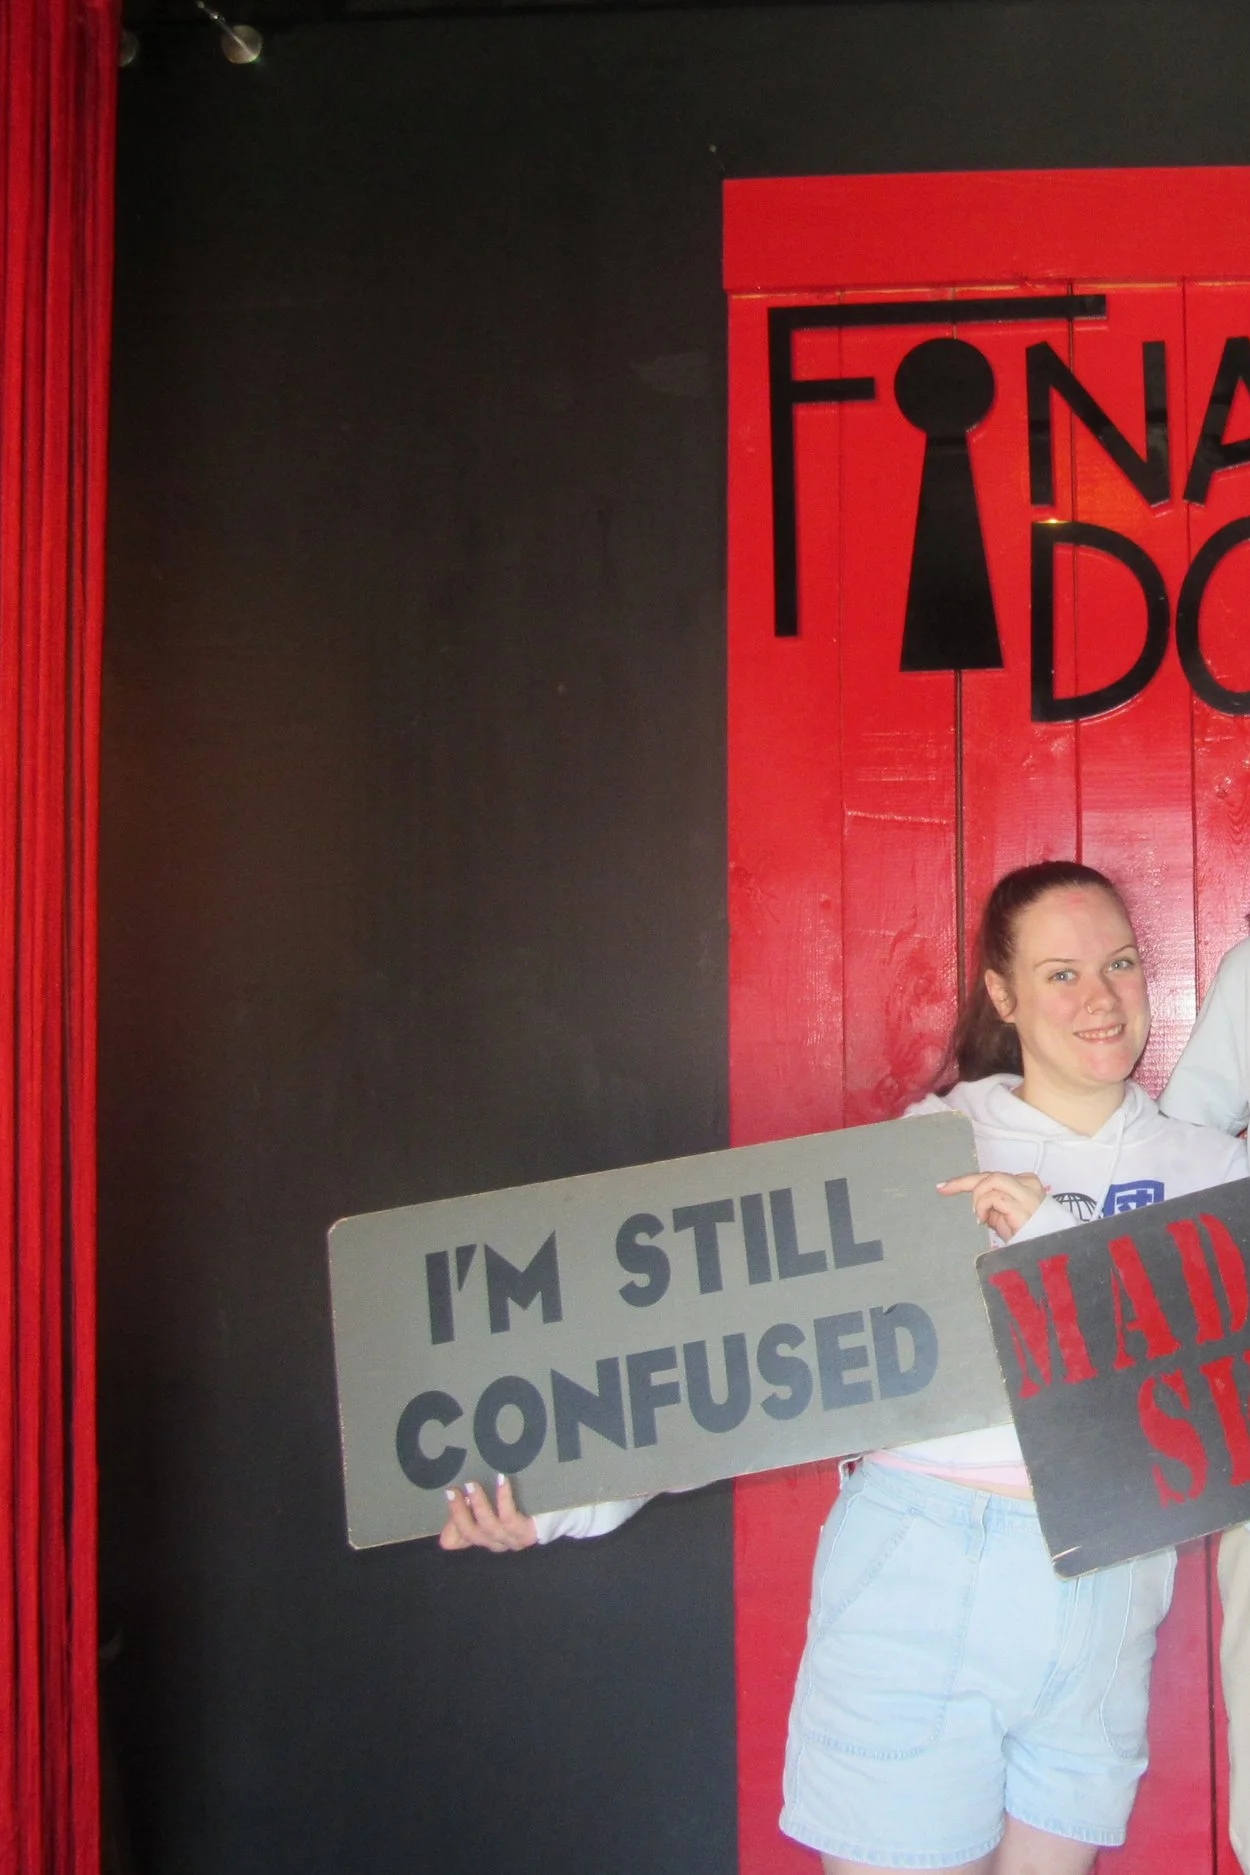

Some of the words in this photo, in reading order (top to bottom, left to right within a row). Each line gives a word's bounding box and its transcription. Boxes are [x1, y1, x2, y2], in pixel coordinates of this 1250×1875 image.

[425, 1229, 563, 1346] I'M
[615, 1177, 884, 1308] STILL
[990, 1214, 1250, 1399] MAD
[395, 1301, 939, 1491] CONFUSED
